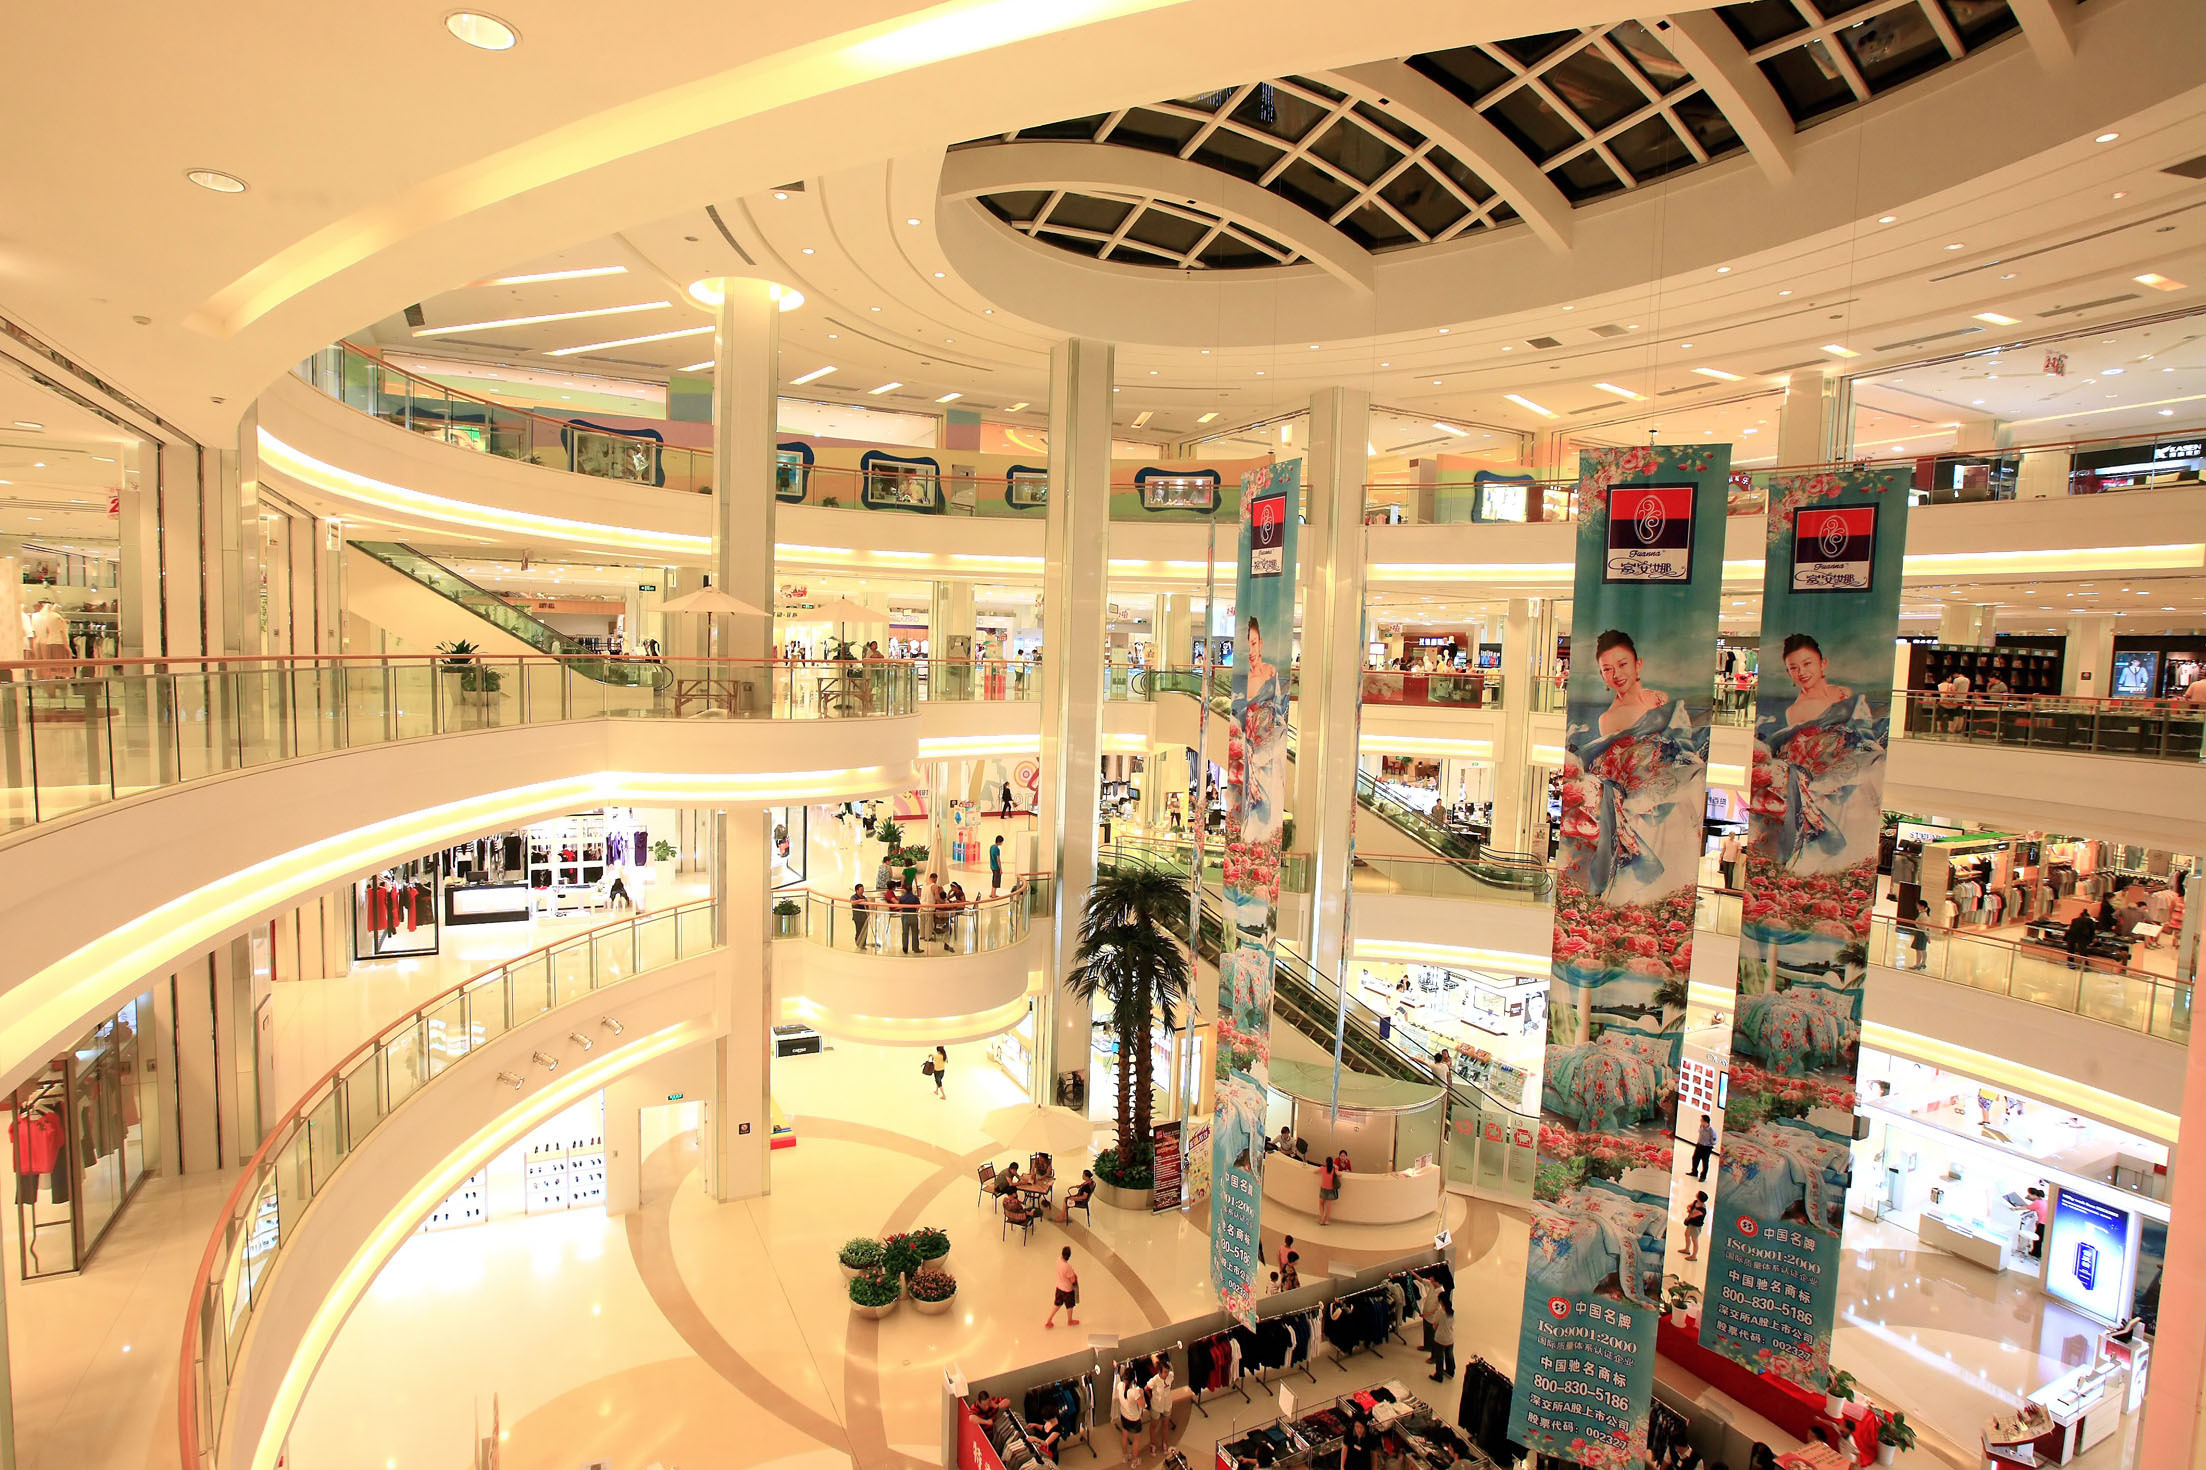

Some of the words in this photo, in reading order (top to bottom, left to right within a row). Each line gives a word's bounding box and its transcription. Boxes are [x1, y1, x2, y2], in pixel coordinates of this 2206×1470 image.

[1726, 1237, 1823, 1275] ISO9001:2000
[1764, 1227, 1817, 1252] 中国名牌
[1728, 1269, 1812, 1304] 中国驰名商标
[1574, 1301, 1632, 1330] 中国名牌
[1718, 1303, 1814, 1345] 深交所A股上市公司
[1721, 1286, 1814, 1326] 800-830-5186
[1537, 1319, 1638, 1354] ISO9001:2000
[1540, 1356, 1627, 1388] 中国驰名商标
[1533, 1373, 1629, 1412] 800-830-5186
[1529, 1393, 1630, 1433] 深交所A股上市公司
